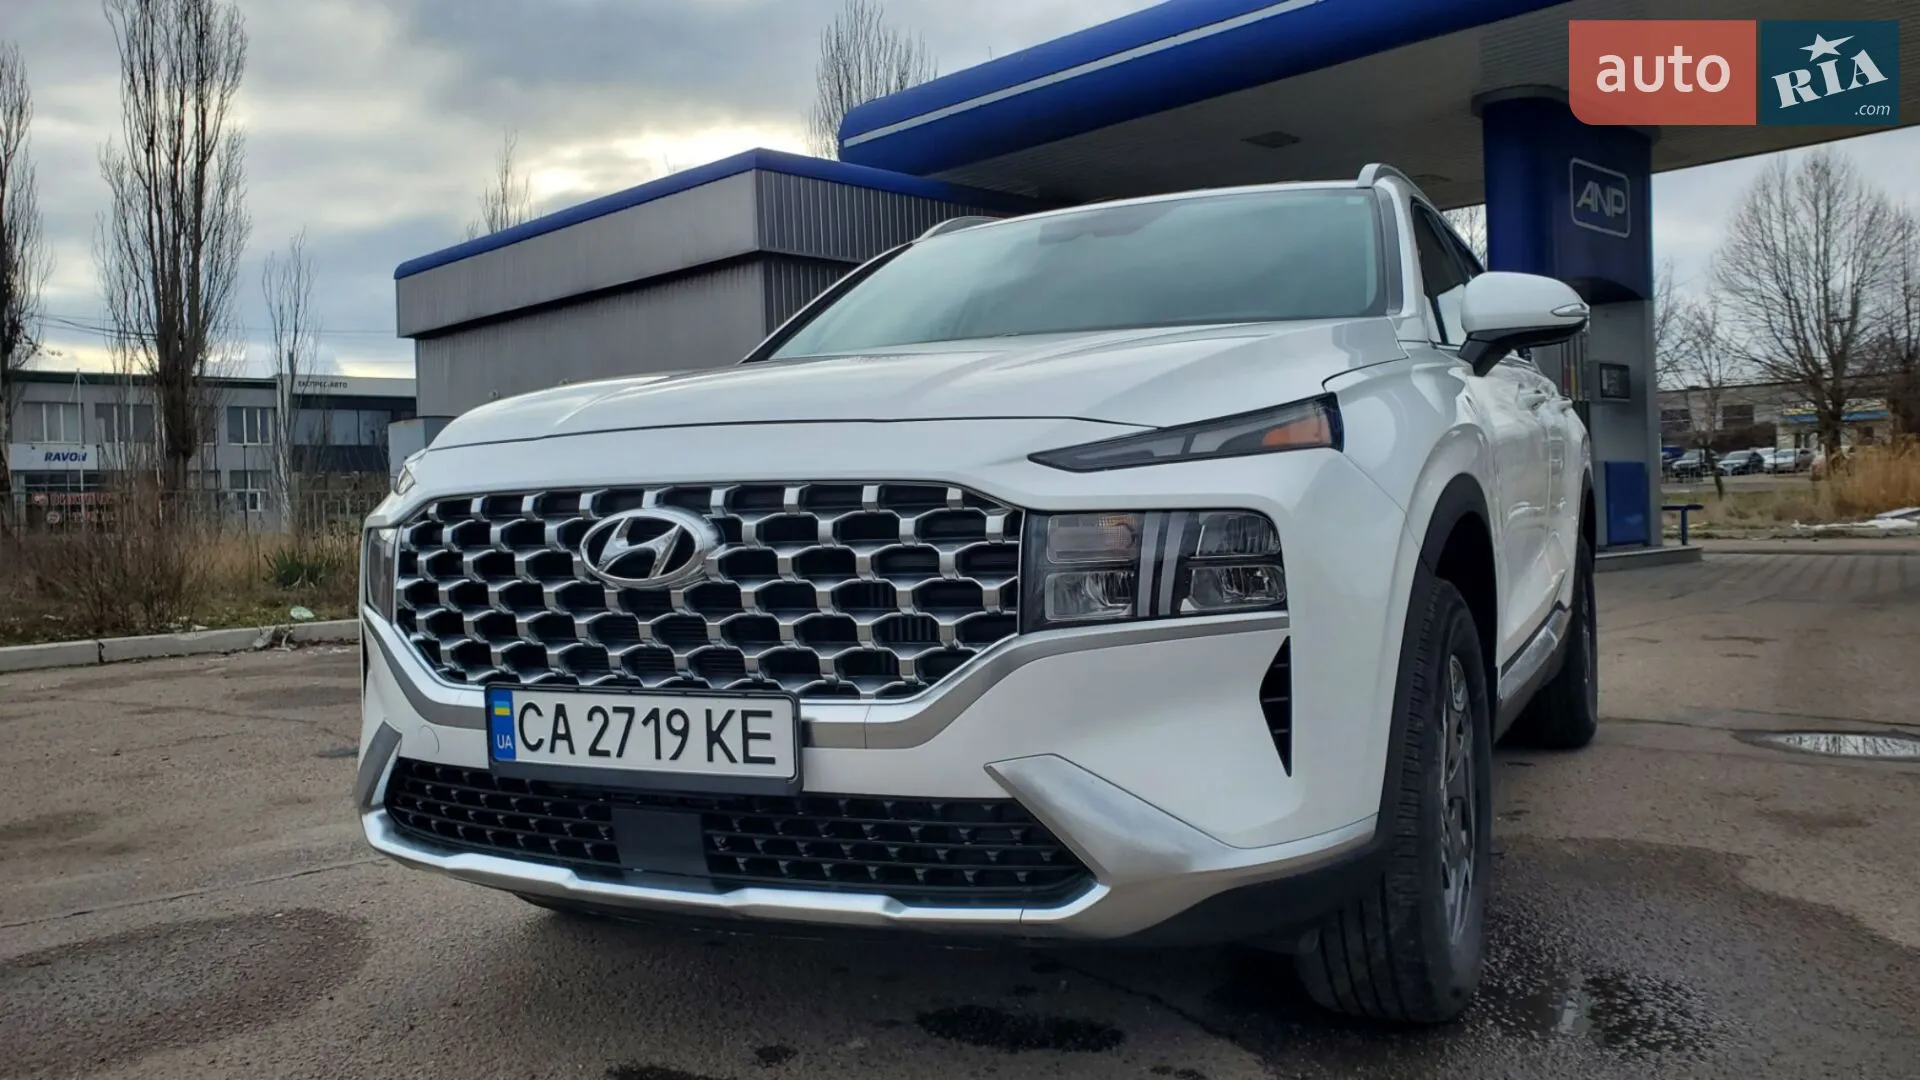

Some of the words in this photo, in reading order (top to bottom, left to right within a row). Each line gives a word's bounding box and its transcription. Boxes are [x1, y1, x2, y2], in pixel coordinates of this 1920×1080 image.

[1576, 181, 1625, 217] ANP
[44, 452, 87, 461] RAVON
[497, 734, 513, 749] UA
[519, 702, 575, 754] CA
[587, 706, 690, 760] 2719
[705, 708, 776, 764] KE
